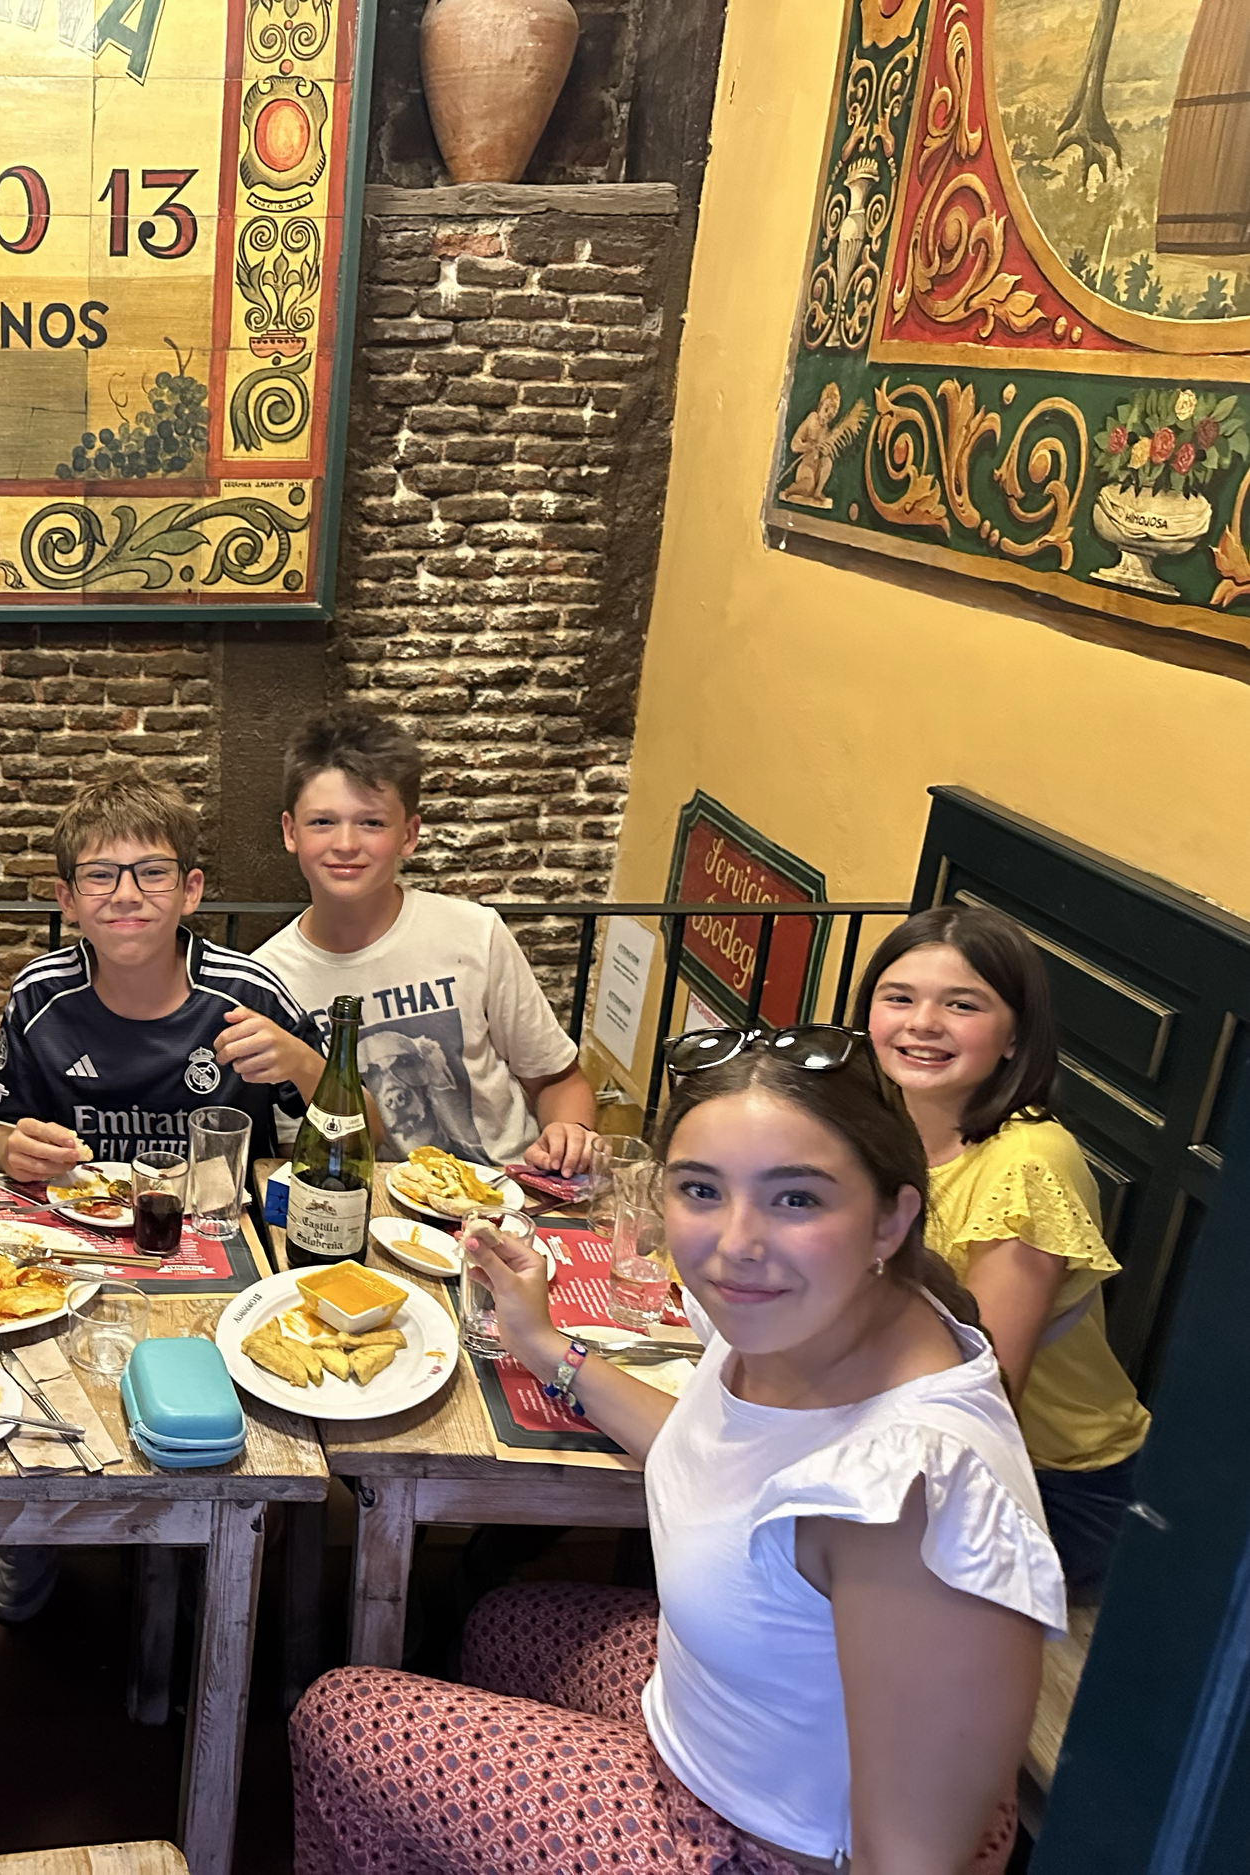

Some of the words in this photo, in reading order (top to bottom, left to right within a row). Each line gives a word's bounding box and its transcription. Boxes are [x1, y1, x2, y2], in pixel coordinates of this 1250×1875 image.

[99, 168, 199, 259] 13
[1125, 513, 1168, 529] HINOJOSA
[372, 976, 456, 1019] THAT
[72, 1104, 219, 1136] Emirates
[99, 1139, 129, 1161] FLY
[302, 1216, 340, 1232] Castillo
[313, 1229, 324, 1239] de
[296, 1231, 343, 1250] Salobreña
